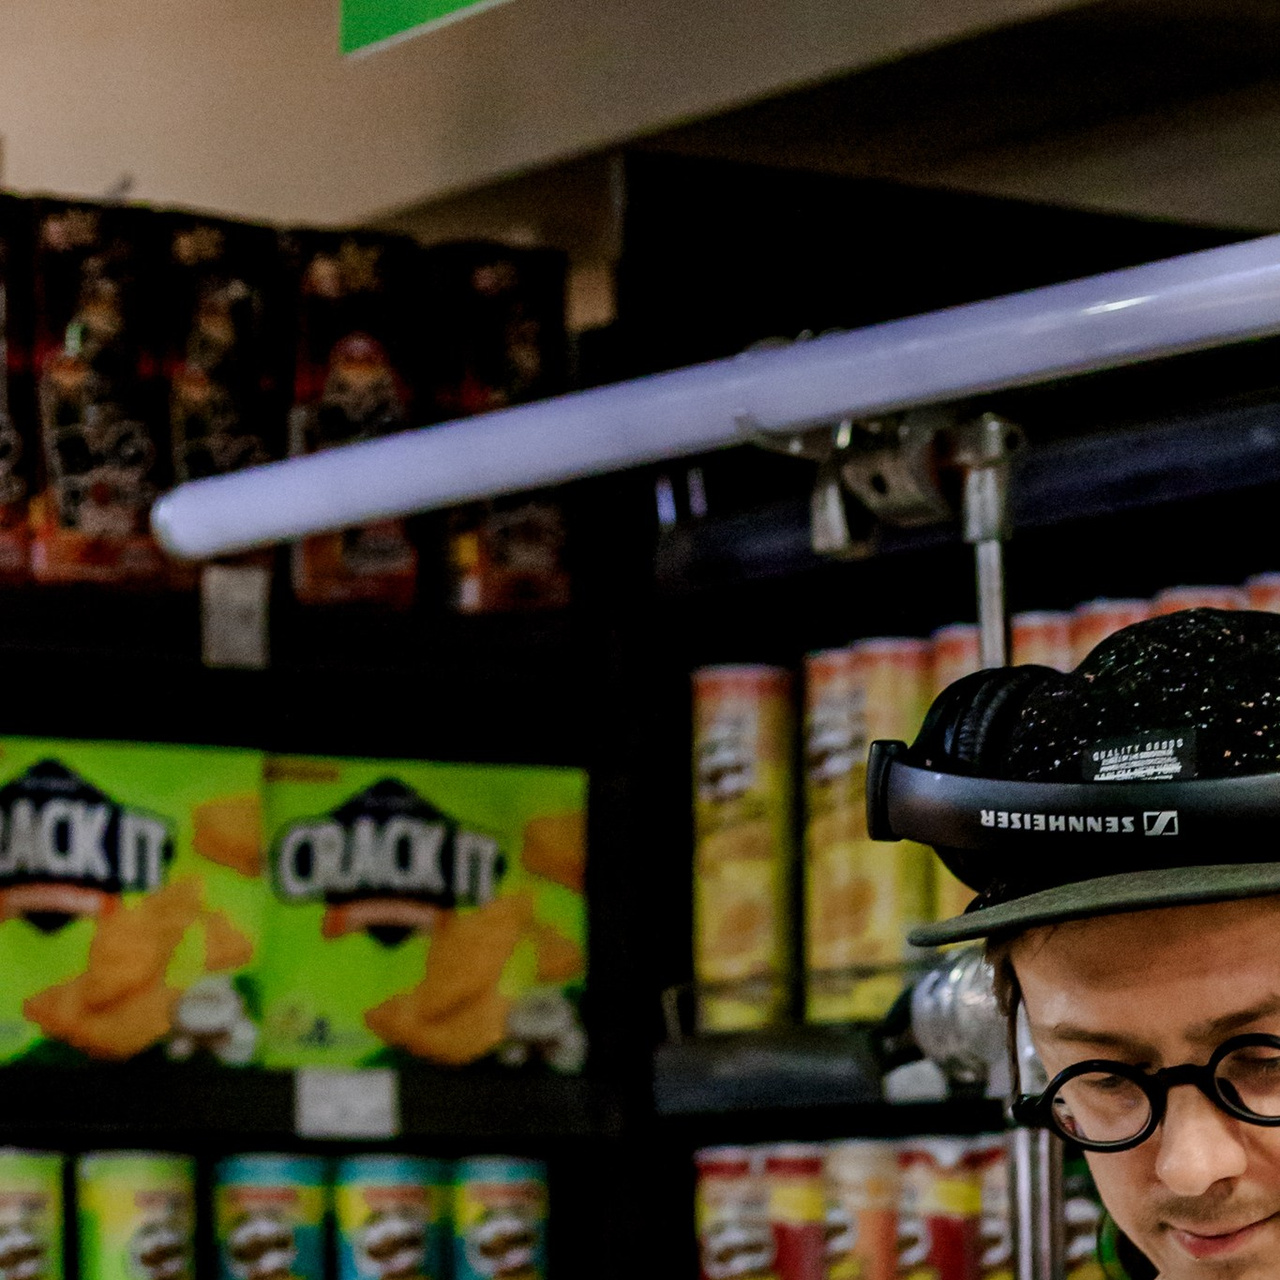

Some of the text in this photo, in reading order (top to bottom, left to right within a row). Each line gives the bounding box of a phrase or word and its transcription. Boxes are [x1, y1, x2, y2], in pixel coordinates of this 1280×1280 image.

[0, 798, 169, 893] ACK IT
[278, 814, 500, 907] CRACK IT
[979, 808, 1136, 834] SENNHEISER
